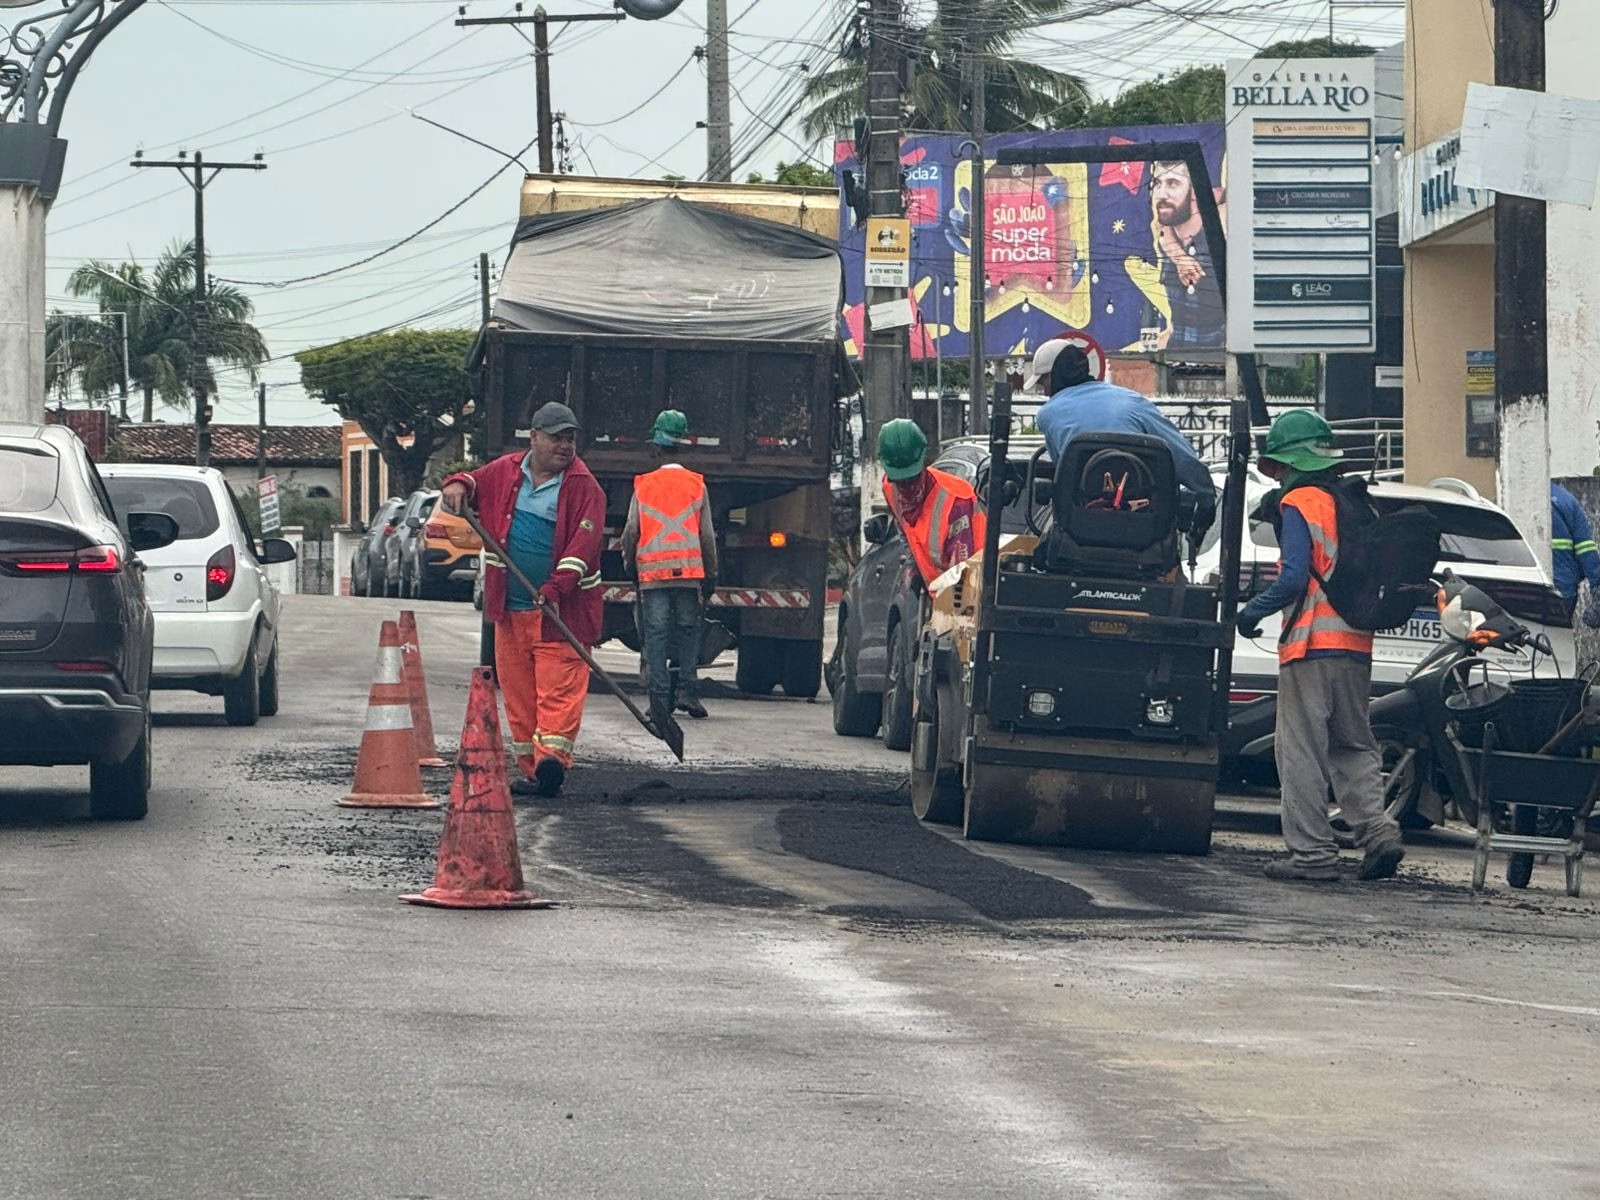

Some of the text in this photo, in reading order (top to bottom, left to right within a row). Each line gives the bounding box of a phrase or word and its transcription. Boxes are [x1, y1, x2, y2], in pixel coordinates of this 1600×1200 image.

[1252, 72, 1350, 82] GALERIA
[1232, 86, 1369, 112] BELLA RIO
[993, 203, 1046, 225] SÃO JOÃO
[991, 227, 1049, 248] super
[991, 245, 1051, 262] moda
[1305, 281, 1332, 293] LEÃO
